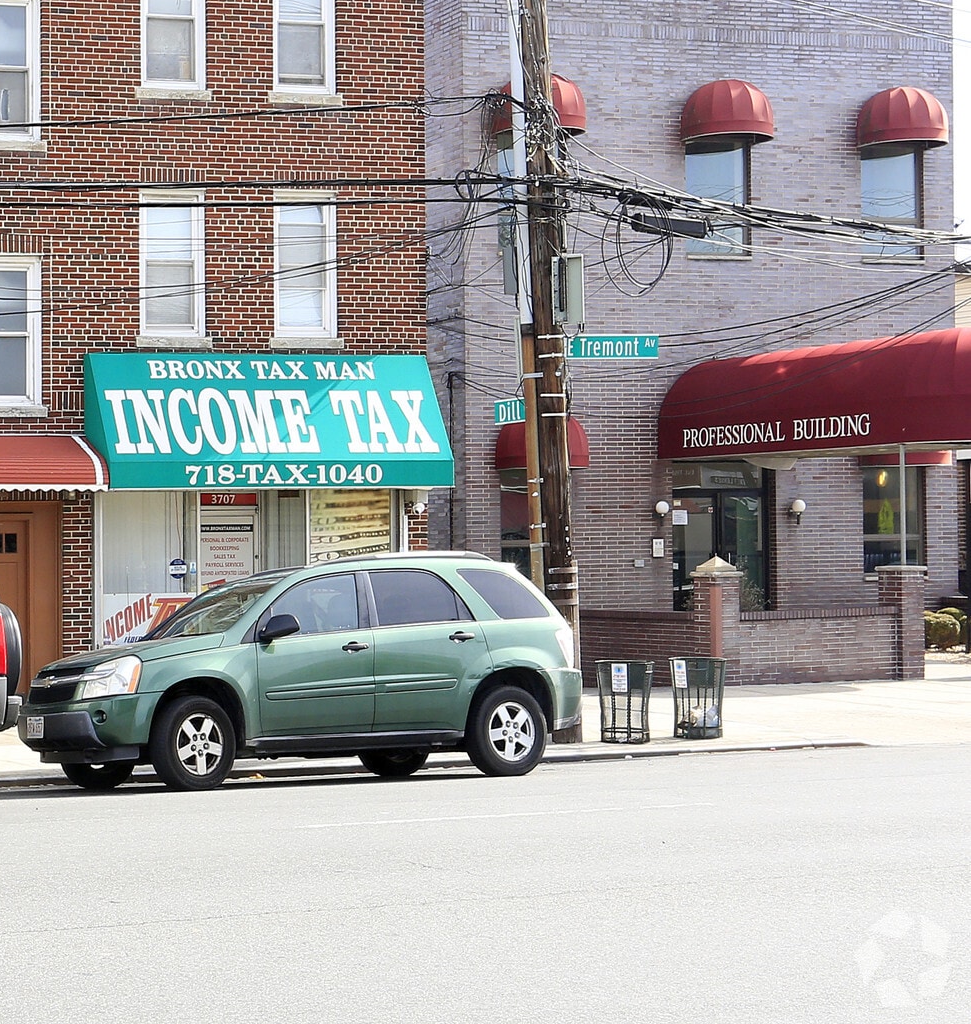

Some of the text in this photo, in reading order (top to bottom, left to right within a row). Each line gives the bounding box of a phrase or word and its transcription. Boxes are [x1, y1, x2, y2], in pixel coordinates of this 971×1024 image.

[567, 337, 656, 357] E Tremont Av
[146, 359, 376, 381] BRONX TAX MAN
[104, 387, 441, 456] INCOME TAX
[499, 401, 521, 422] Dill
[682, 413, 871, 448] PROFESSIONAL BUILDING
[185, 463, 383, 486] 718-TAX-1040
[211, 494, 236, 504] 3707
